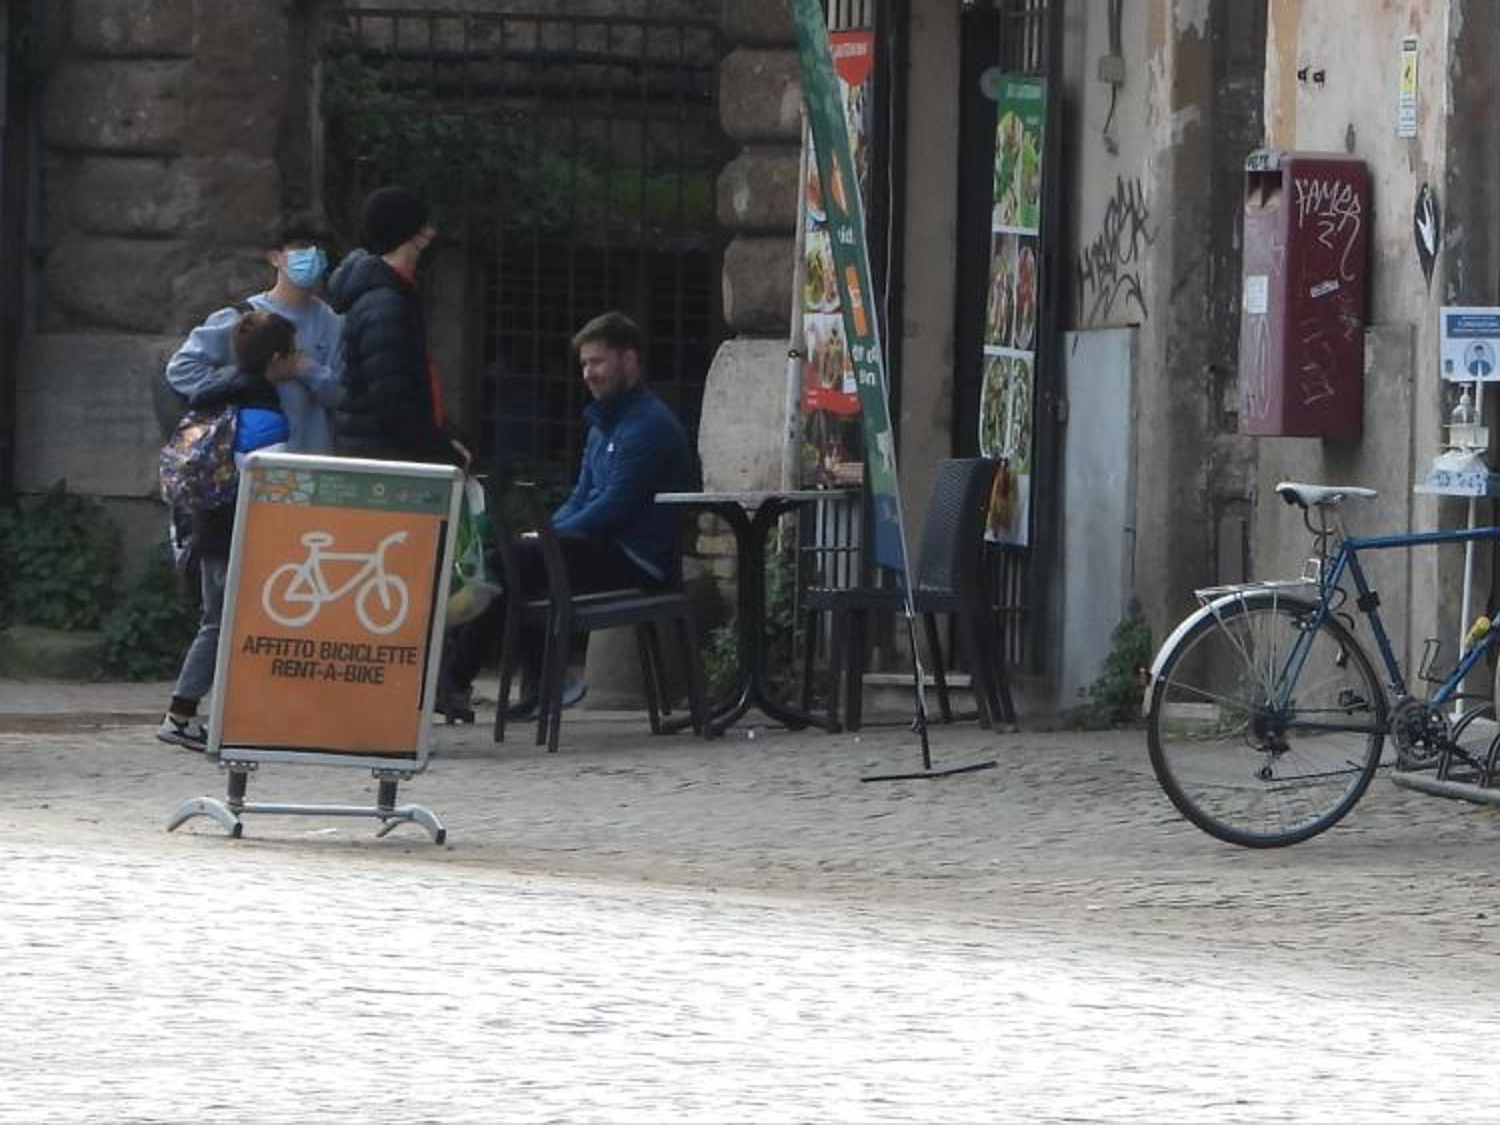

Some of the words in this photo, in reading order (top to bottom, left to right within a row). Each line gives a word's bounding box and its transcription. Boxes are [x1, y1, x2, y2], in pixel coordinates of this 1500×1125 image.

[242, 635, 316, 659] AFFITTO
[319, 640, 417, 666] BICICLETTE
[271, 659, 385, 686] RENT-A-BIKE
